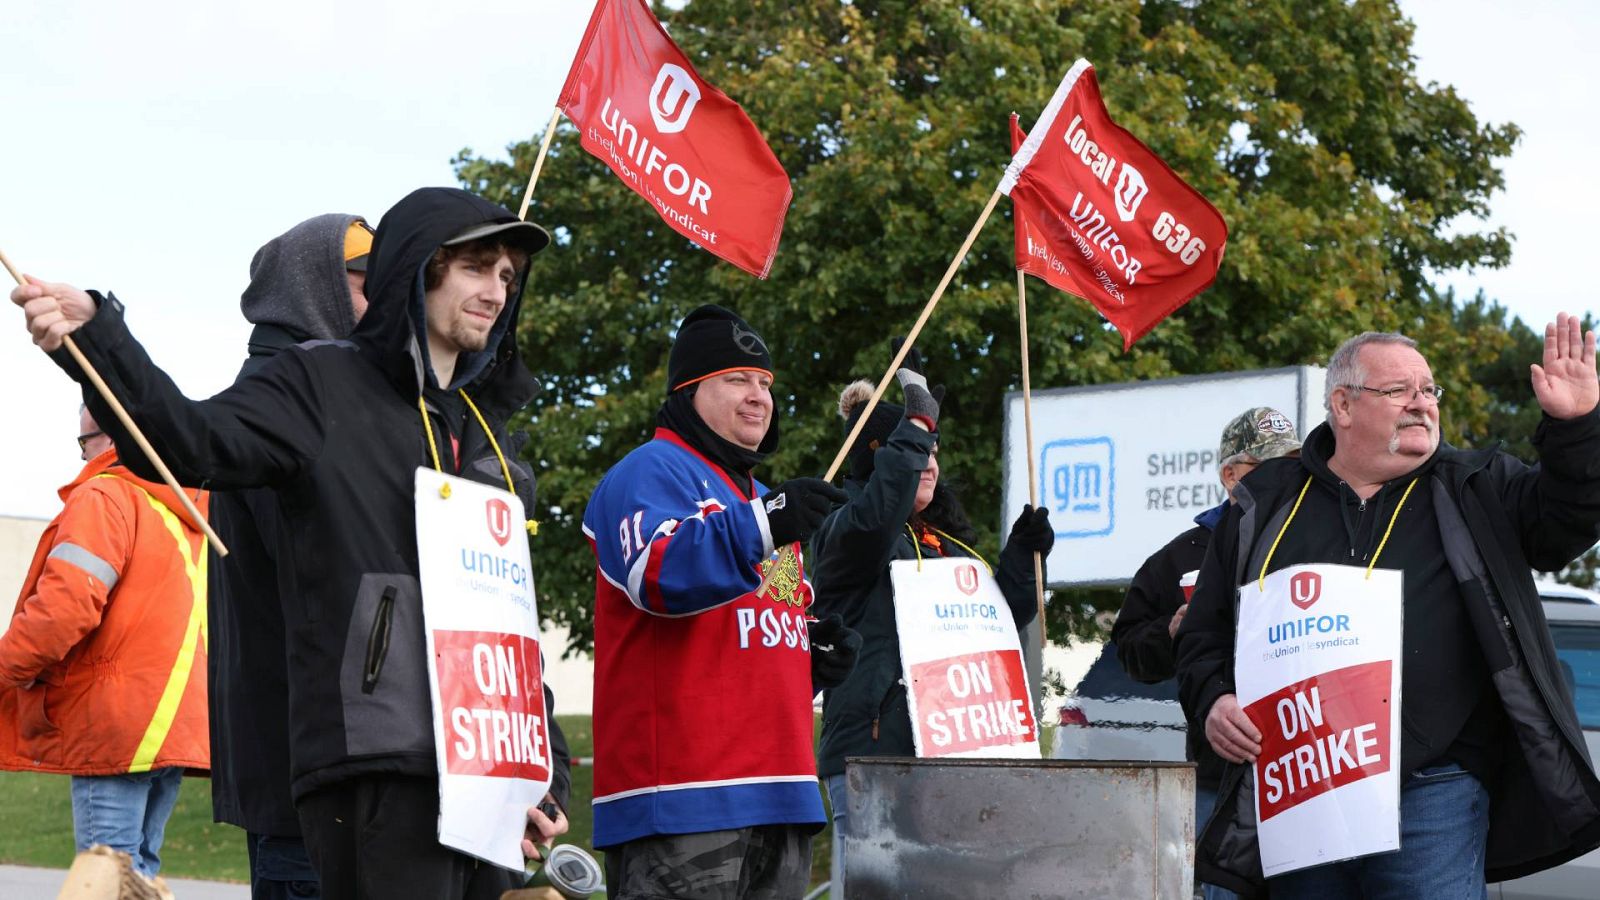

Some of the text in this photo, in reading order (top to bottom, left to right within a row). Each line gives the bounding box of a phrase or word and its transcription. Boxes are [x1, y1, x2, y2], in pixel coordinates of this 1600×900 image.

[1063, 114, 1117, 187] Local
[1152, 211, 1207, 266] 636
[1054, 463, 1102, 512] gm
[1146, 483, 1226, 511] RECEIV
[619, 510, 645, 566] 91
[736, 608, 811, 652] РОСС
[472, 643, 518, 697] ON
[946, 660, 993, 698] ON
[451, 706, 546, 766] STRIKE
[926, 699, 1030, 747] STRIKE
[1276, 686, 1324, 741] ON
[1264, 722, 1380, 804] STRIKE
